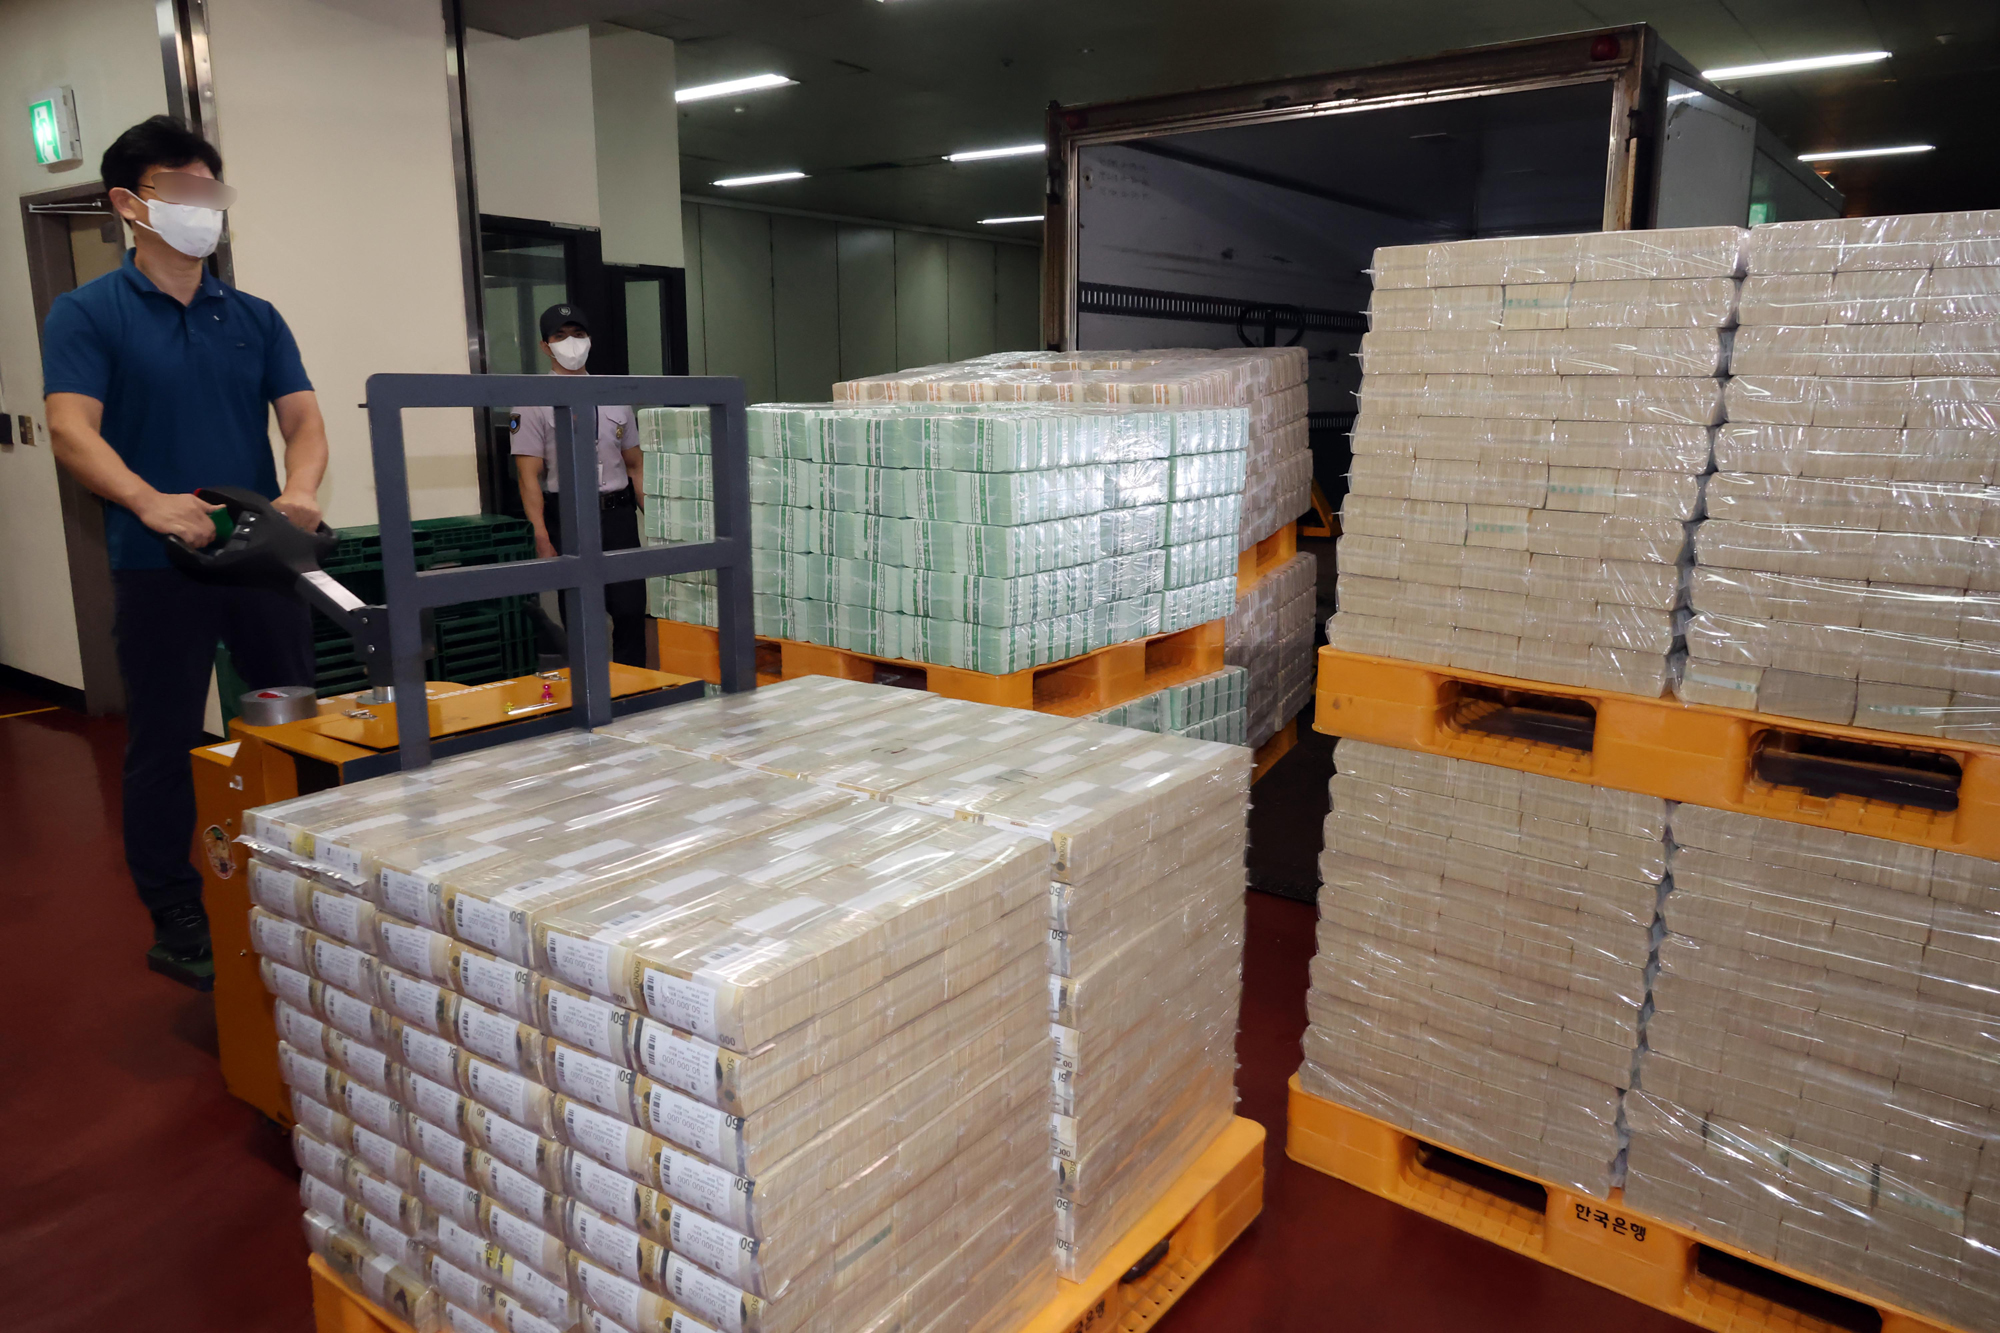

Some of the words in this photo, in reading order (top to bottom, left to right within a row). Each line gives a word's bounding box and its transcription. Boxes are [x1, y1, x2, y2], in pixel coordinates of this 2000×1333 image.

[1051, 929, 1062, 940] 50
[1062, 1060, 1072, 1068] 00
[667, 1113, 705, 1133] 50,000,000
[1056, 1199, 1067, 1210] 50
[1575, 1203, 1647, 1242] 한국은행
